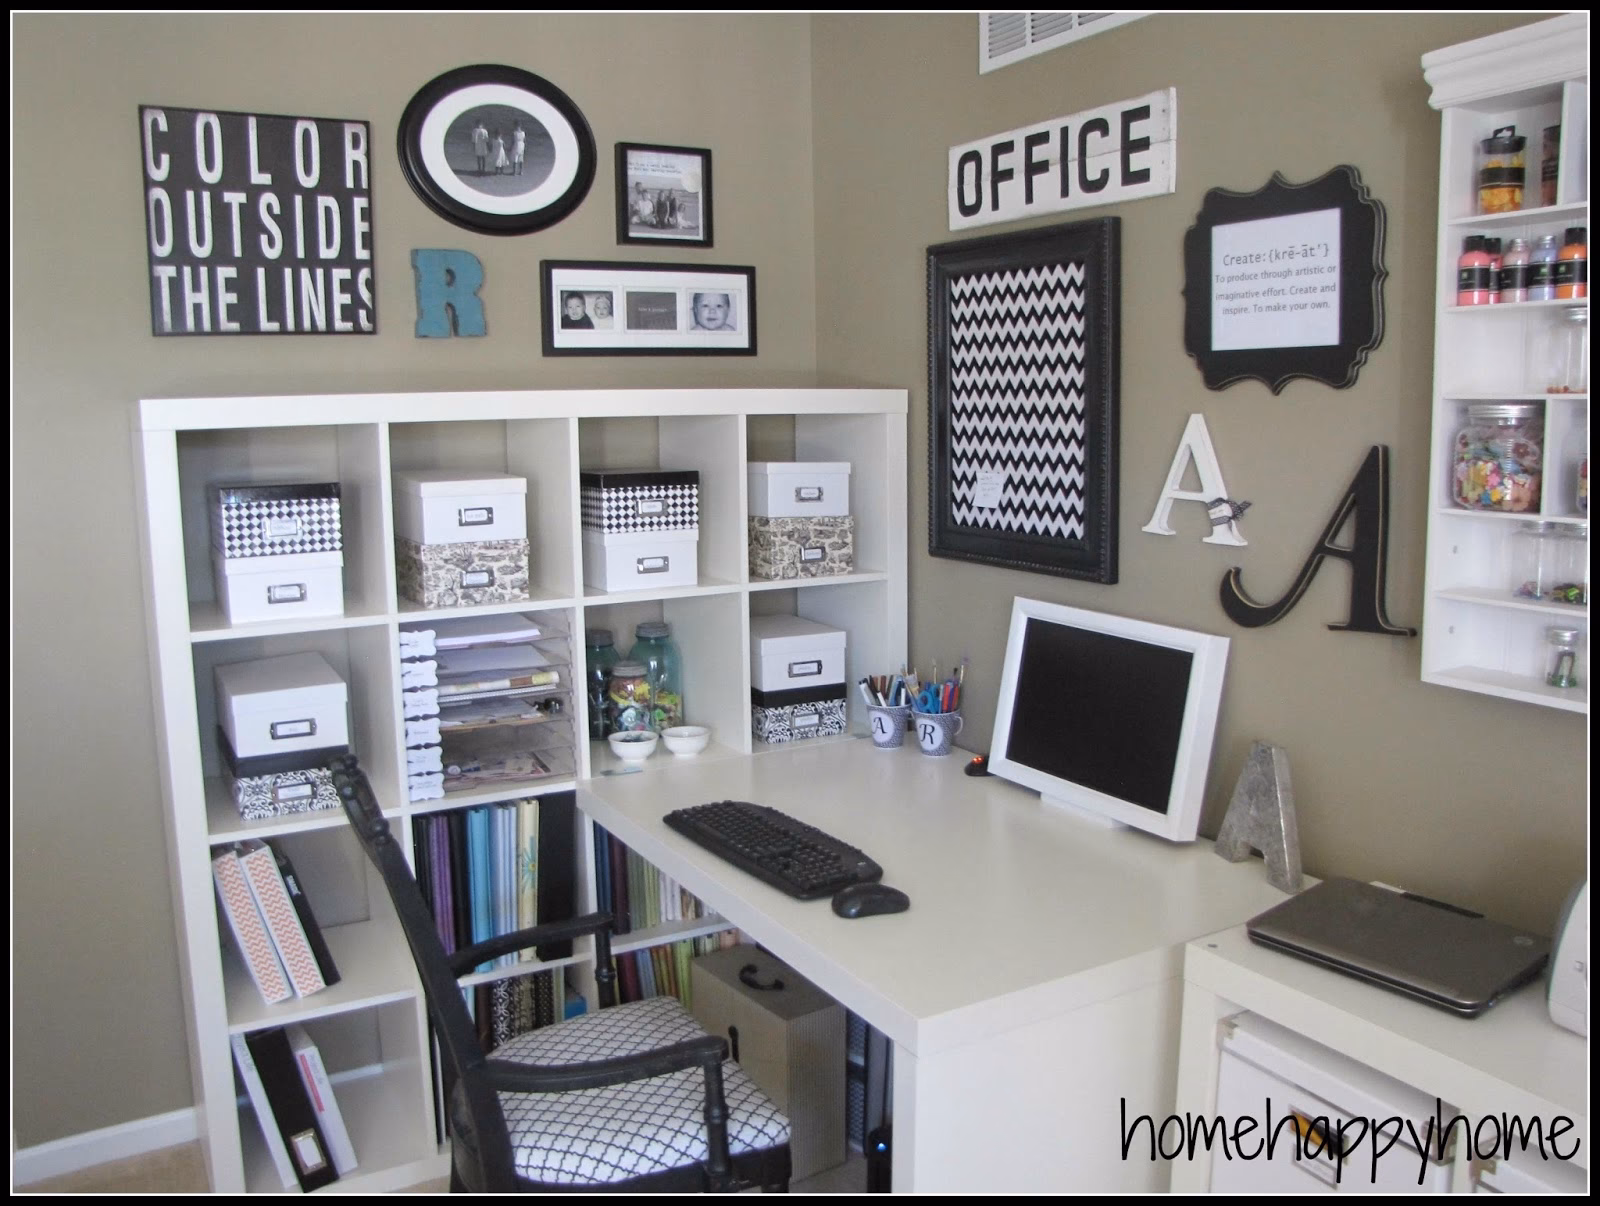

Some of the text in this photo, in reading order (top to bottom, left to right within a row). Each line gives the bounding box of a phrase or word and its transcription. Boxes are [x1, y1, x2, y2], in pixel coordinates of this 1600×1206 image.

[143, 107, 368, 189] COLOR
[957, 104, 1151, 218] OFFICE
[149, 187, 370, 260] OUTSIDE
[153, 265, 373, 333] THE LINES
[410, 248, 487, 338] R
[1215, 265, 1336, 284] To produce through artistic or
[1215, 282, 1337, 302] imaginative effort. Create and
[1222, 300, 1331, 315] inspire. To make your own.
[1141, 413, 1248, 546] A
[1219, 444, 1417, 637] A
[872, 716, 888, 734] A
[920, 723, 936, 745] R
